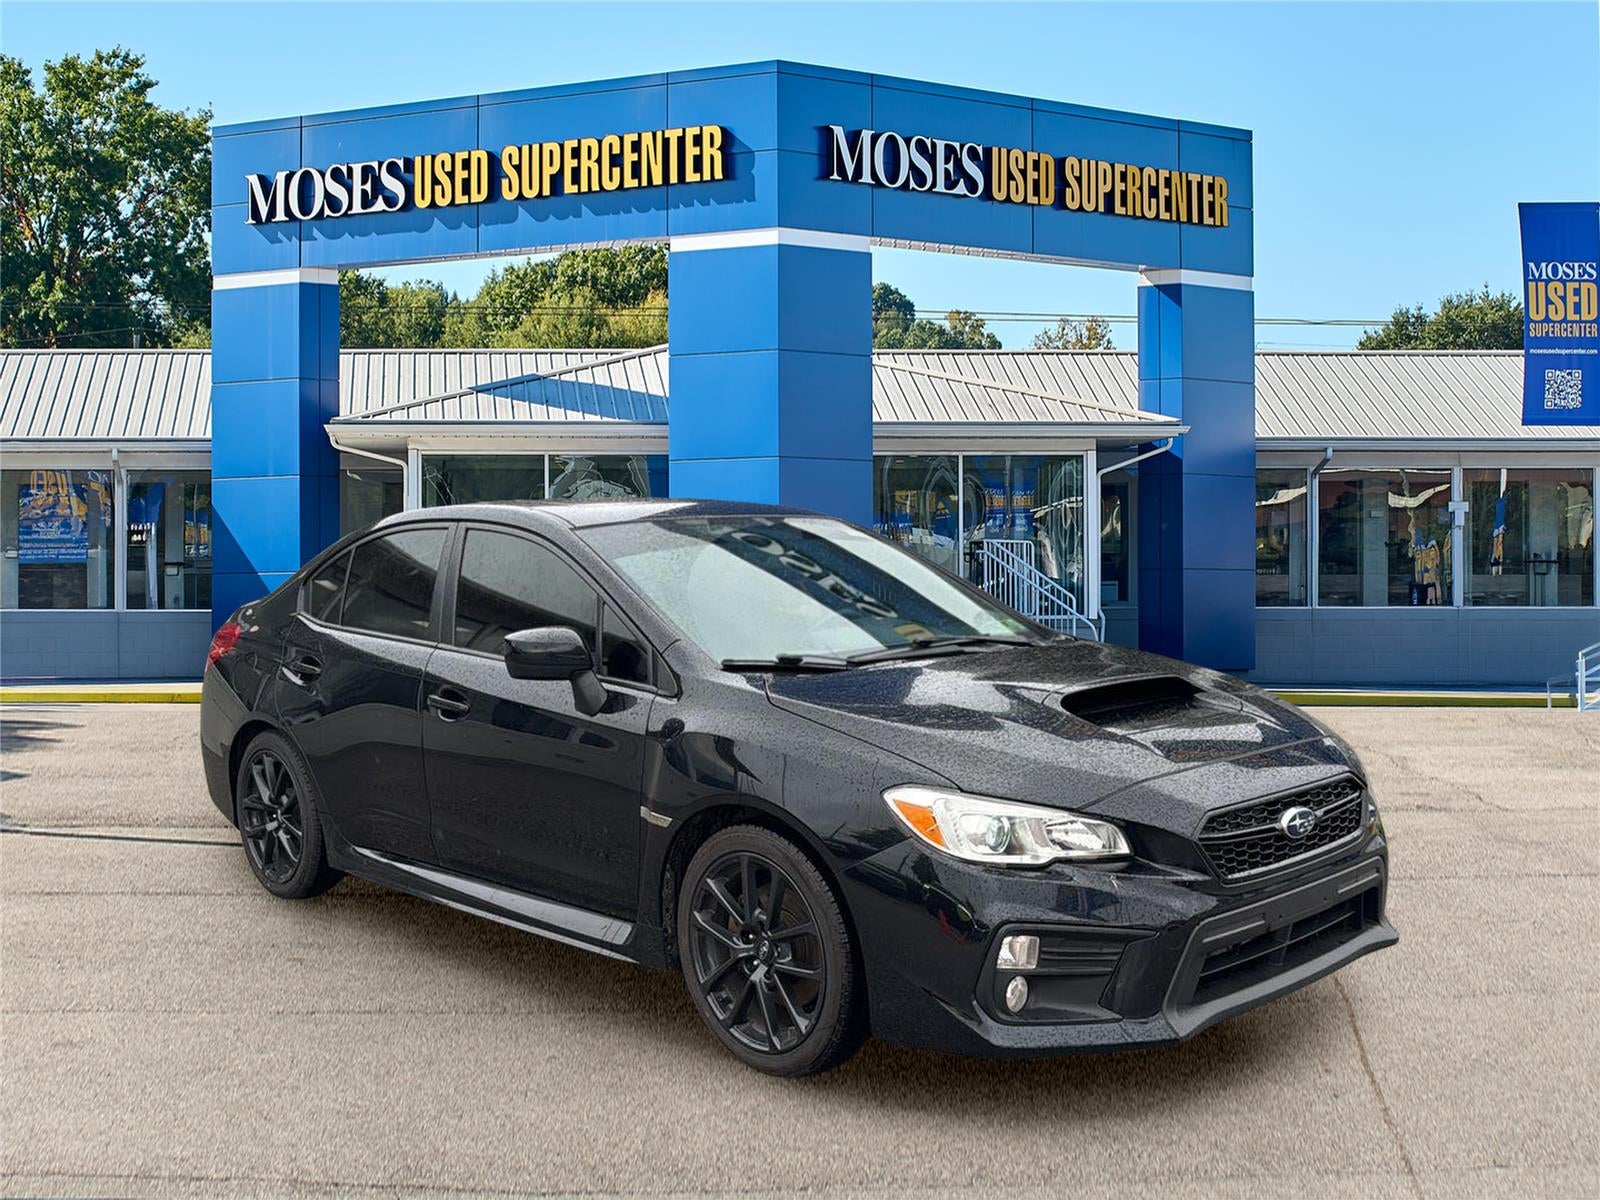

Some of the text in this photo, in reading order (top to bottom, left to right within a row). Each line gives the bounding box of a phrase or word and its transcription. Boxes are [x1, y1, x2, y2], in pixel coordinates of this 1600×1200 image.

[244, 124, 723, 225] MOSES USED SUPERCENTER
[828, 124, 1230, 227] MOSES USED SUPERCENTER
[1527, 262, 1597, 280] MOSES
[1529, 282, 1598, 321] USED
[1529, 323, 1598, 338] SUPERCENTER
